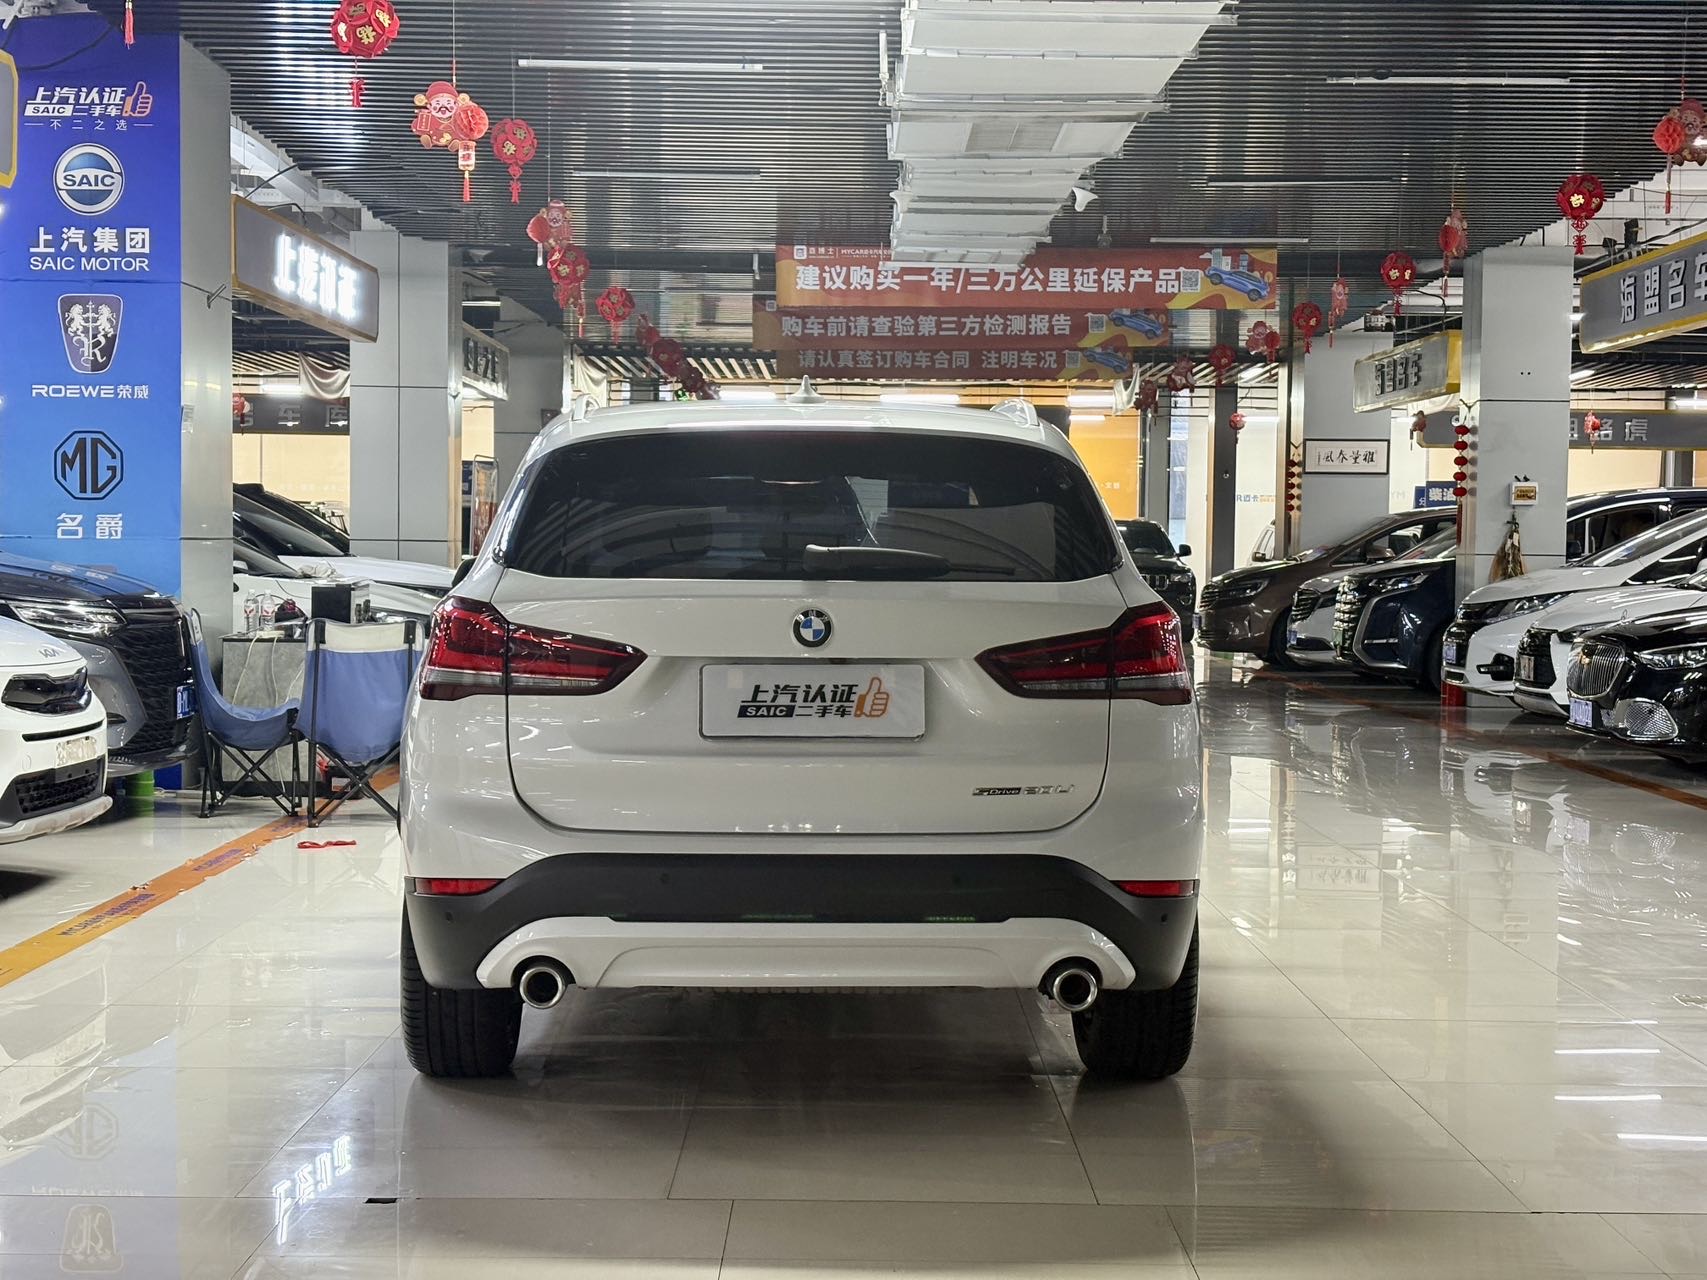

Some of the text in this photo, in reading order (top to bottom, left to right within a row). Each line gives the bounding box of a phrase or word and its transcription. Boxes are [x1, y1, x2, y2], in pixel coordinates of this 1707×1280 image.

[27, 86, 126, 105] 上汽认证
[31, 105, 122, 117] SAIC 二手车
[50, 119, 128, 131] 不二之选
[63, 173, 116, 187] SAIC
[29, 226, 150, 254] 上汽集团
[30, 256, 150, 272] SAIC MOTOR
[796, 265, 1179, 294] 建议购买一年/三万公里延保产品
[781, 314, 1072, 337] 购车前请查验第三方检测报告
[800, 351, 1057, 369] 请认真签订购车合同 注明车况
[32, 384, 149, 399] ROEWE 荣威
[61, 437, 117, 494] MG
[56, 512, 123, 540] 名爵
[740, 683, 859, 703] 上汽认证
[745, 704, 853, 718] SAIC 二手车
